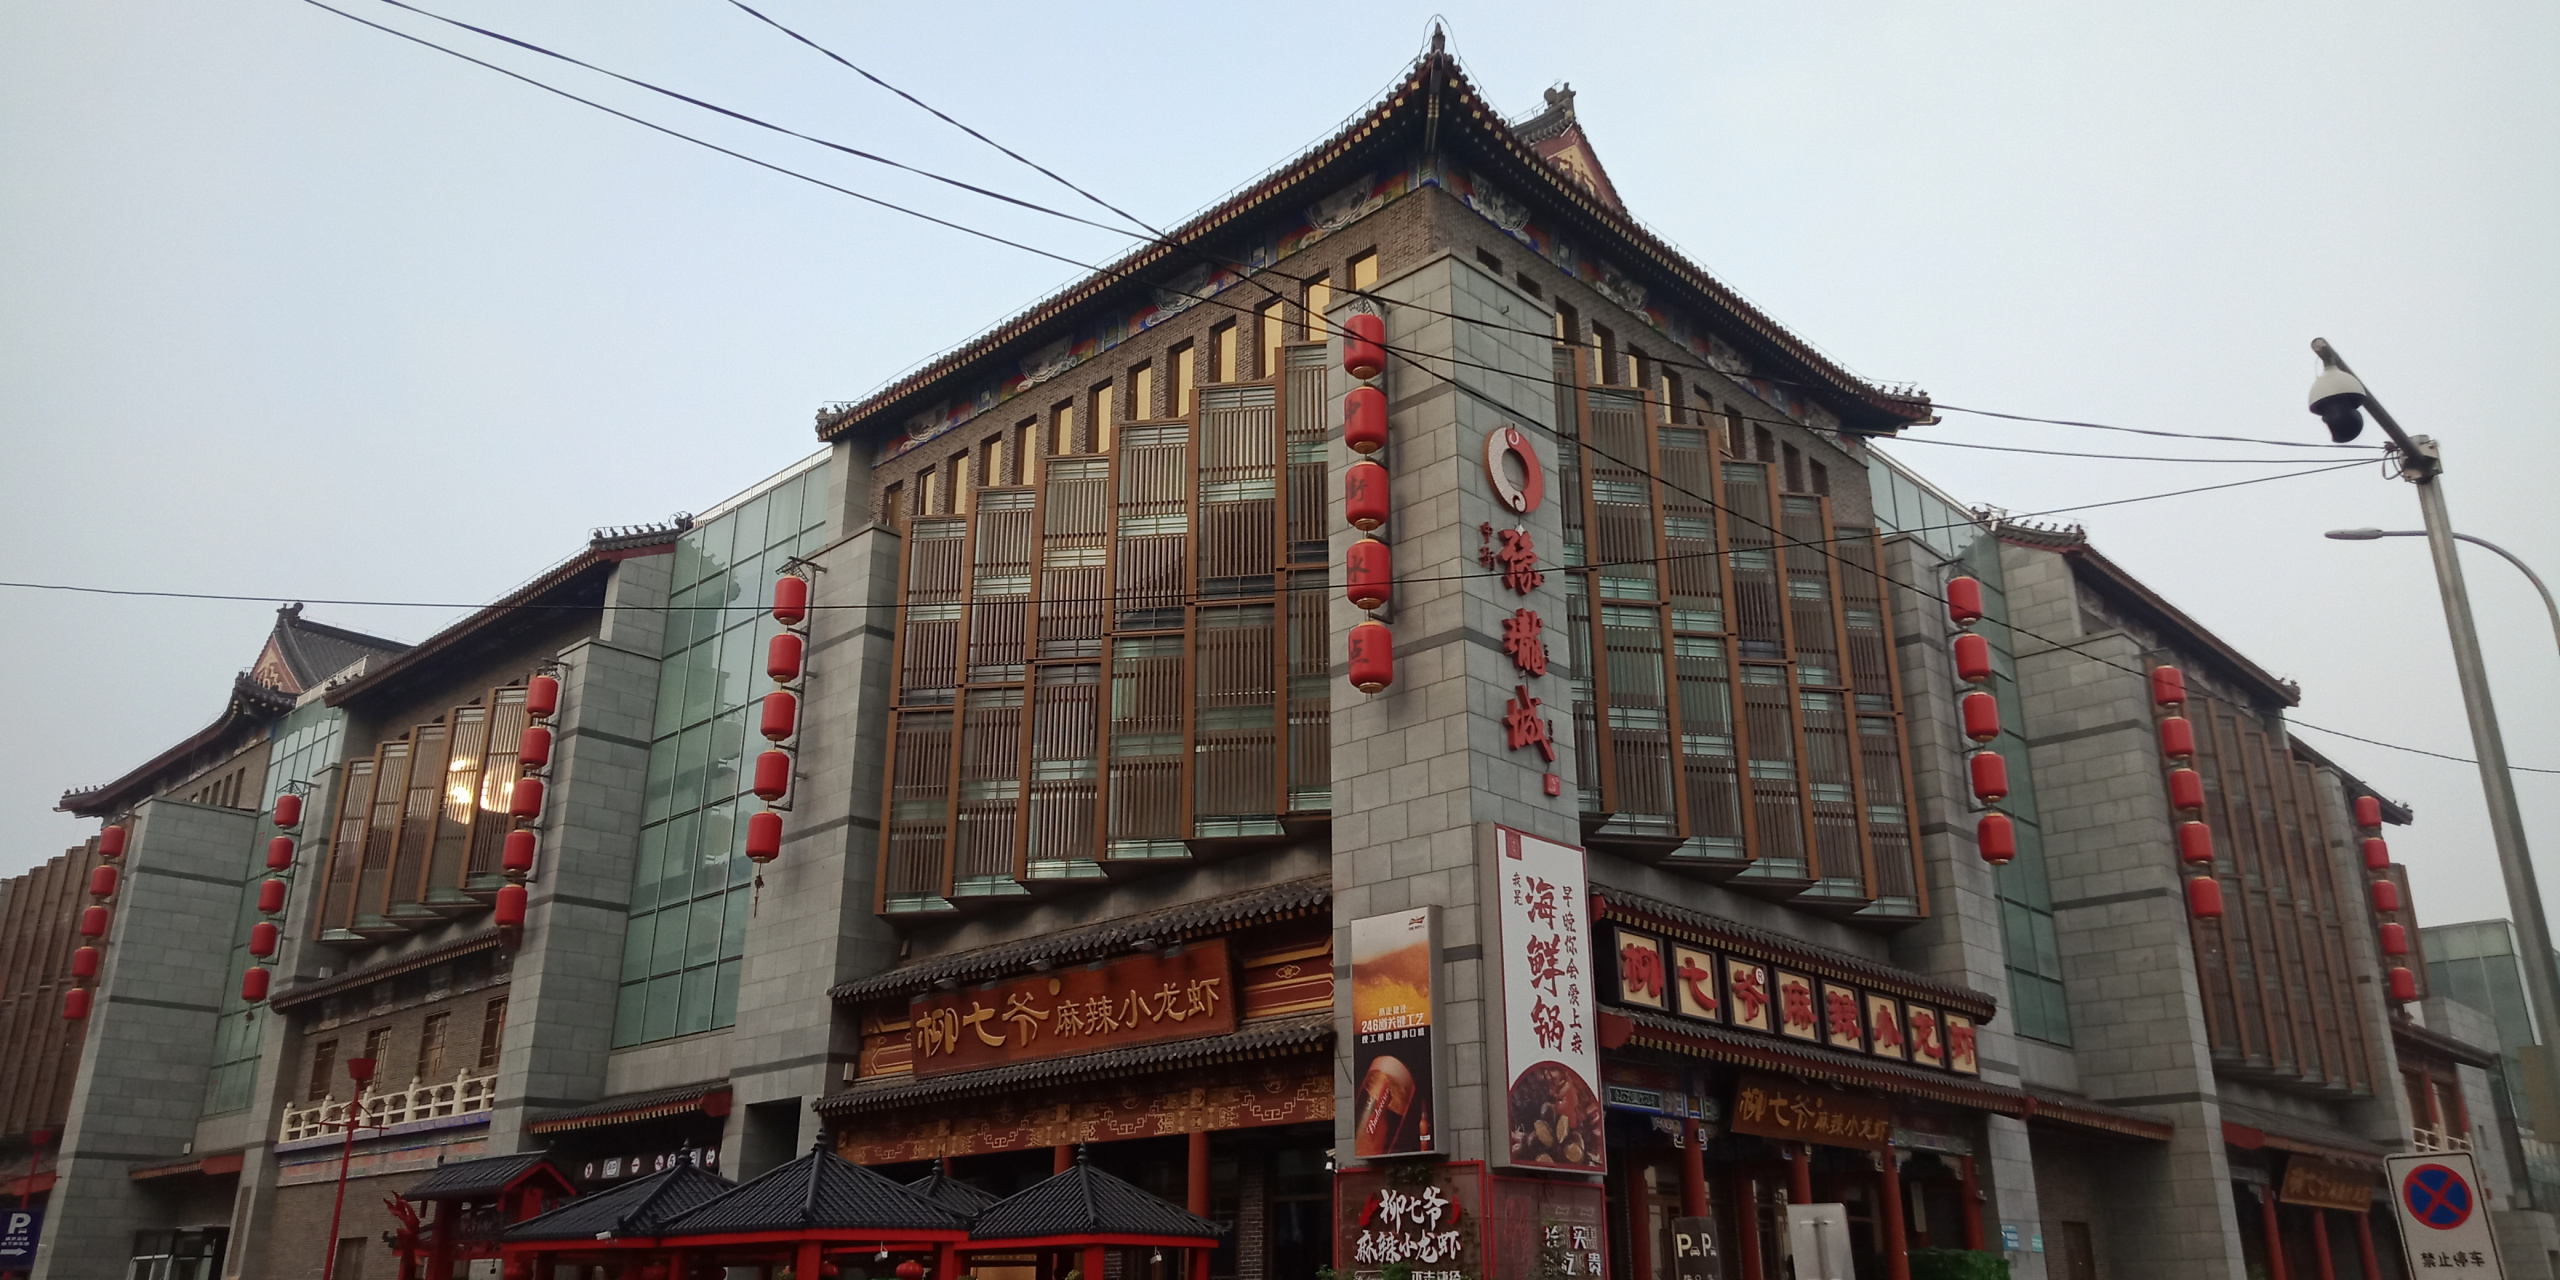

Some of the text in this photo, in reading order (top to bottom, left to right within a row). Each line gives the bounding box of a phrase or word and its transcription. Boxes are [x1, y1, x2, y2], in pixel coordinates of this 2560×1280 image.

[1512, 872, 1523, 906] 我是
[1525, 875, 1565, 1053] 海鲜锅
[915, 977, 1221, 1058] 柳七爷 麻辣小龙虾
[1738, 1087, 1815, 1131] 柳七爷
[8, 1212, 31, 1234] P
[1379, 1185, 1449, 1235] 柳七爷
[1354, 1229, 1462, 1264] 麻辣小龙虾
[1676, 1233, 1711, 1257] P P
[2420, 1251, 2485, 1268] 禁止停车
